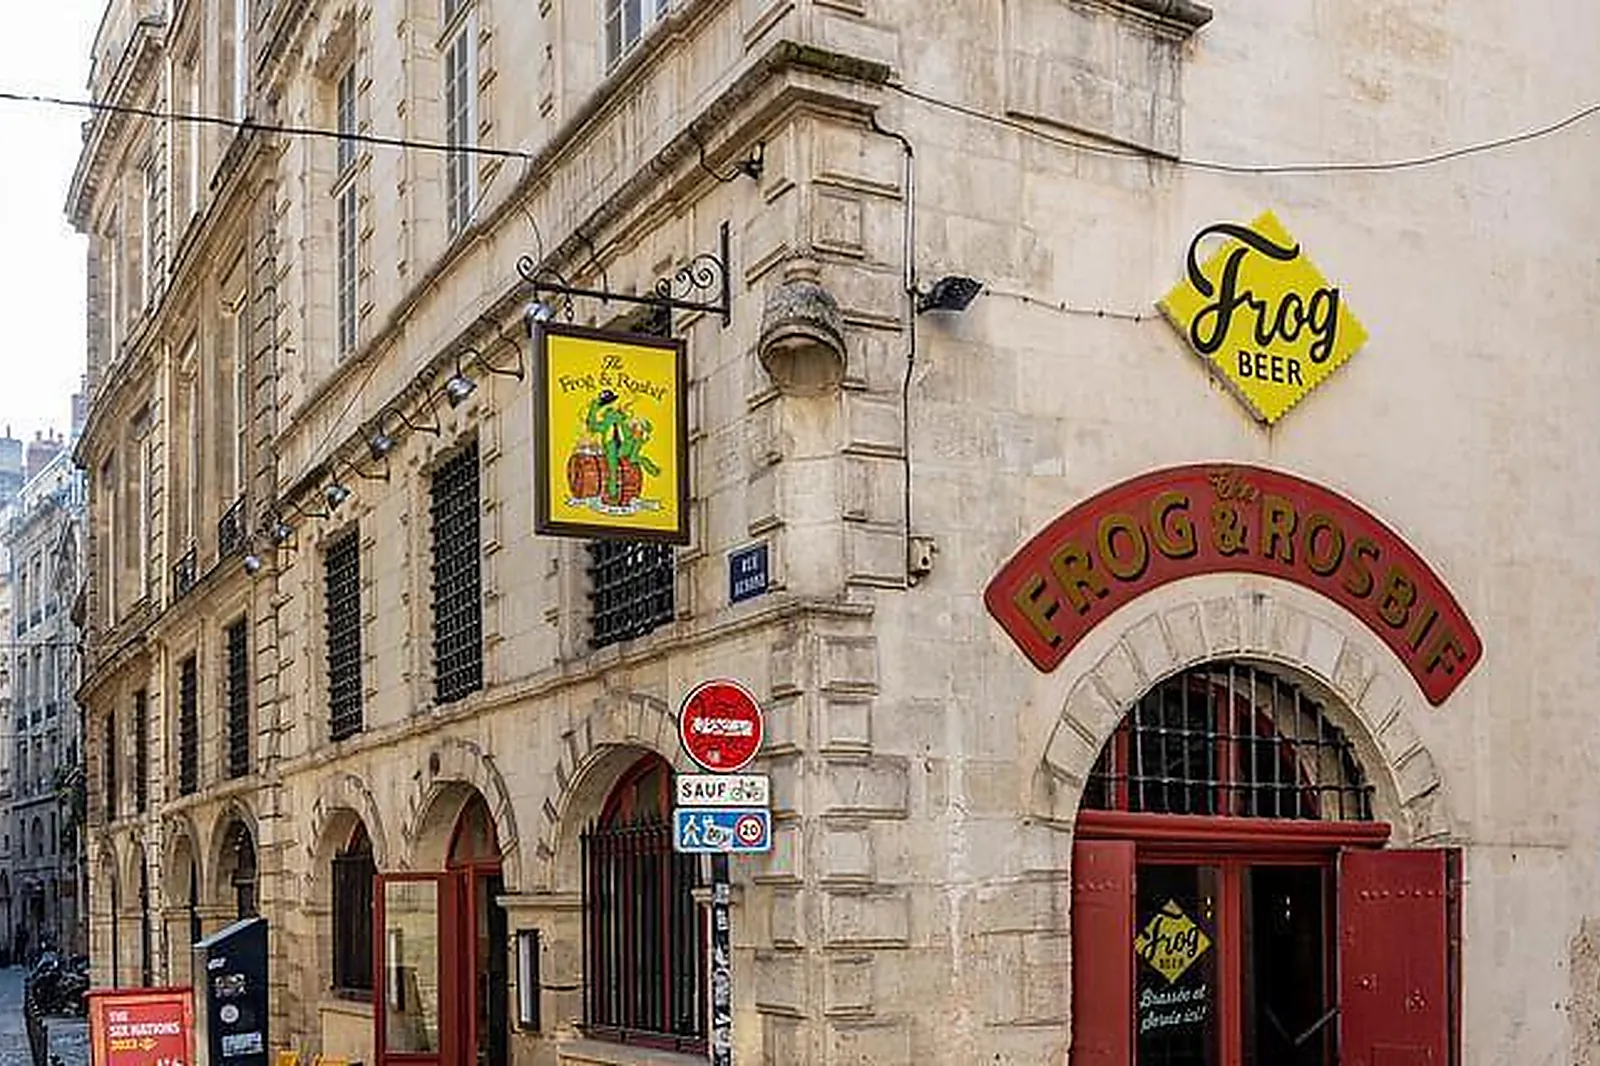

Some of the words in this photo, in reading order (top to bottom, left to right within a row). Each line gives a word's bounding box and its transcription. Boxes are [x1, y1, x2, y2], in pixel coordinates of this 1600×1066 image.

[1187, 223, 1340, 364] Frog
[600, 354, 623, 371] The
[1237, 350, 1304, 387] BEER
[558, 374, 597, 394] Frog
[599, 372, 613, 387] &
[1209, 470, 1260, 504] The
[1013, 491, 1199, 649] FROG
[1211, 504, 1249, 556] &
[1262, 494, 1468, 677] ROSBIF
[681, 781, 728, 799] SAUF
[1142, 905, 1199, 962] Frog
